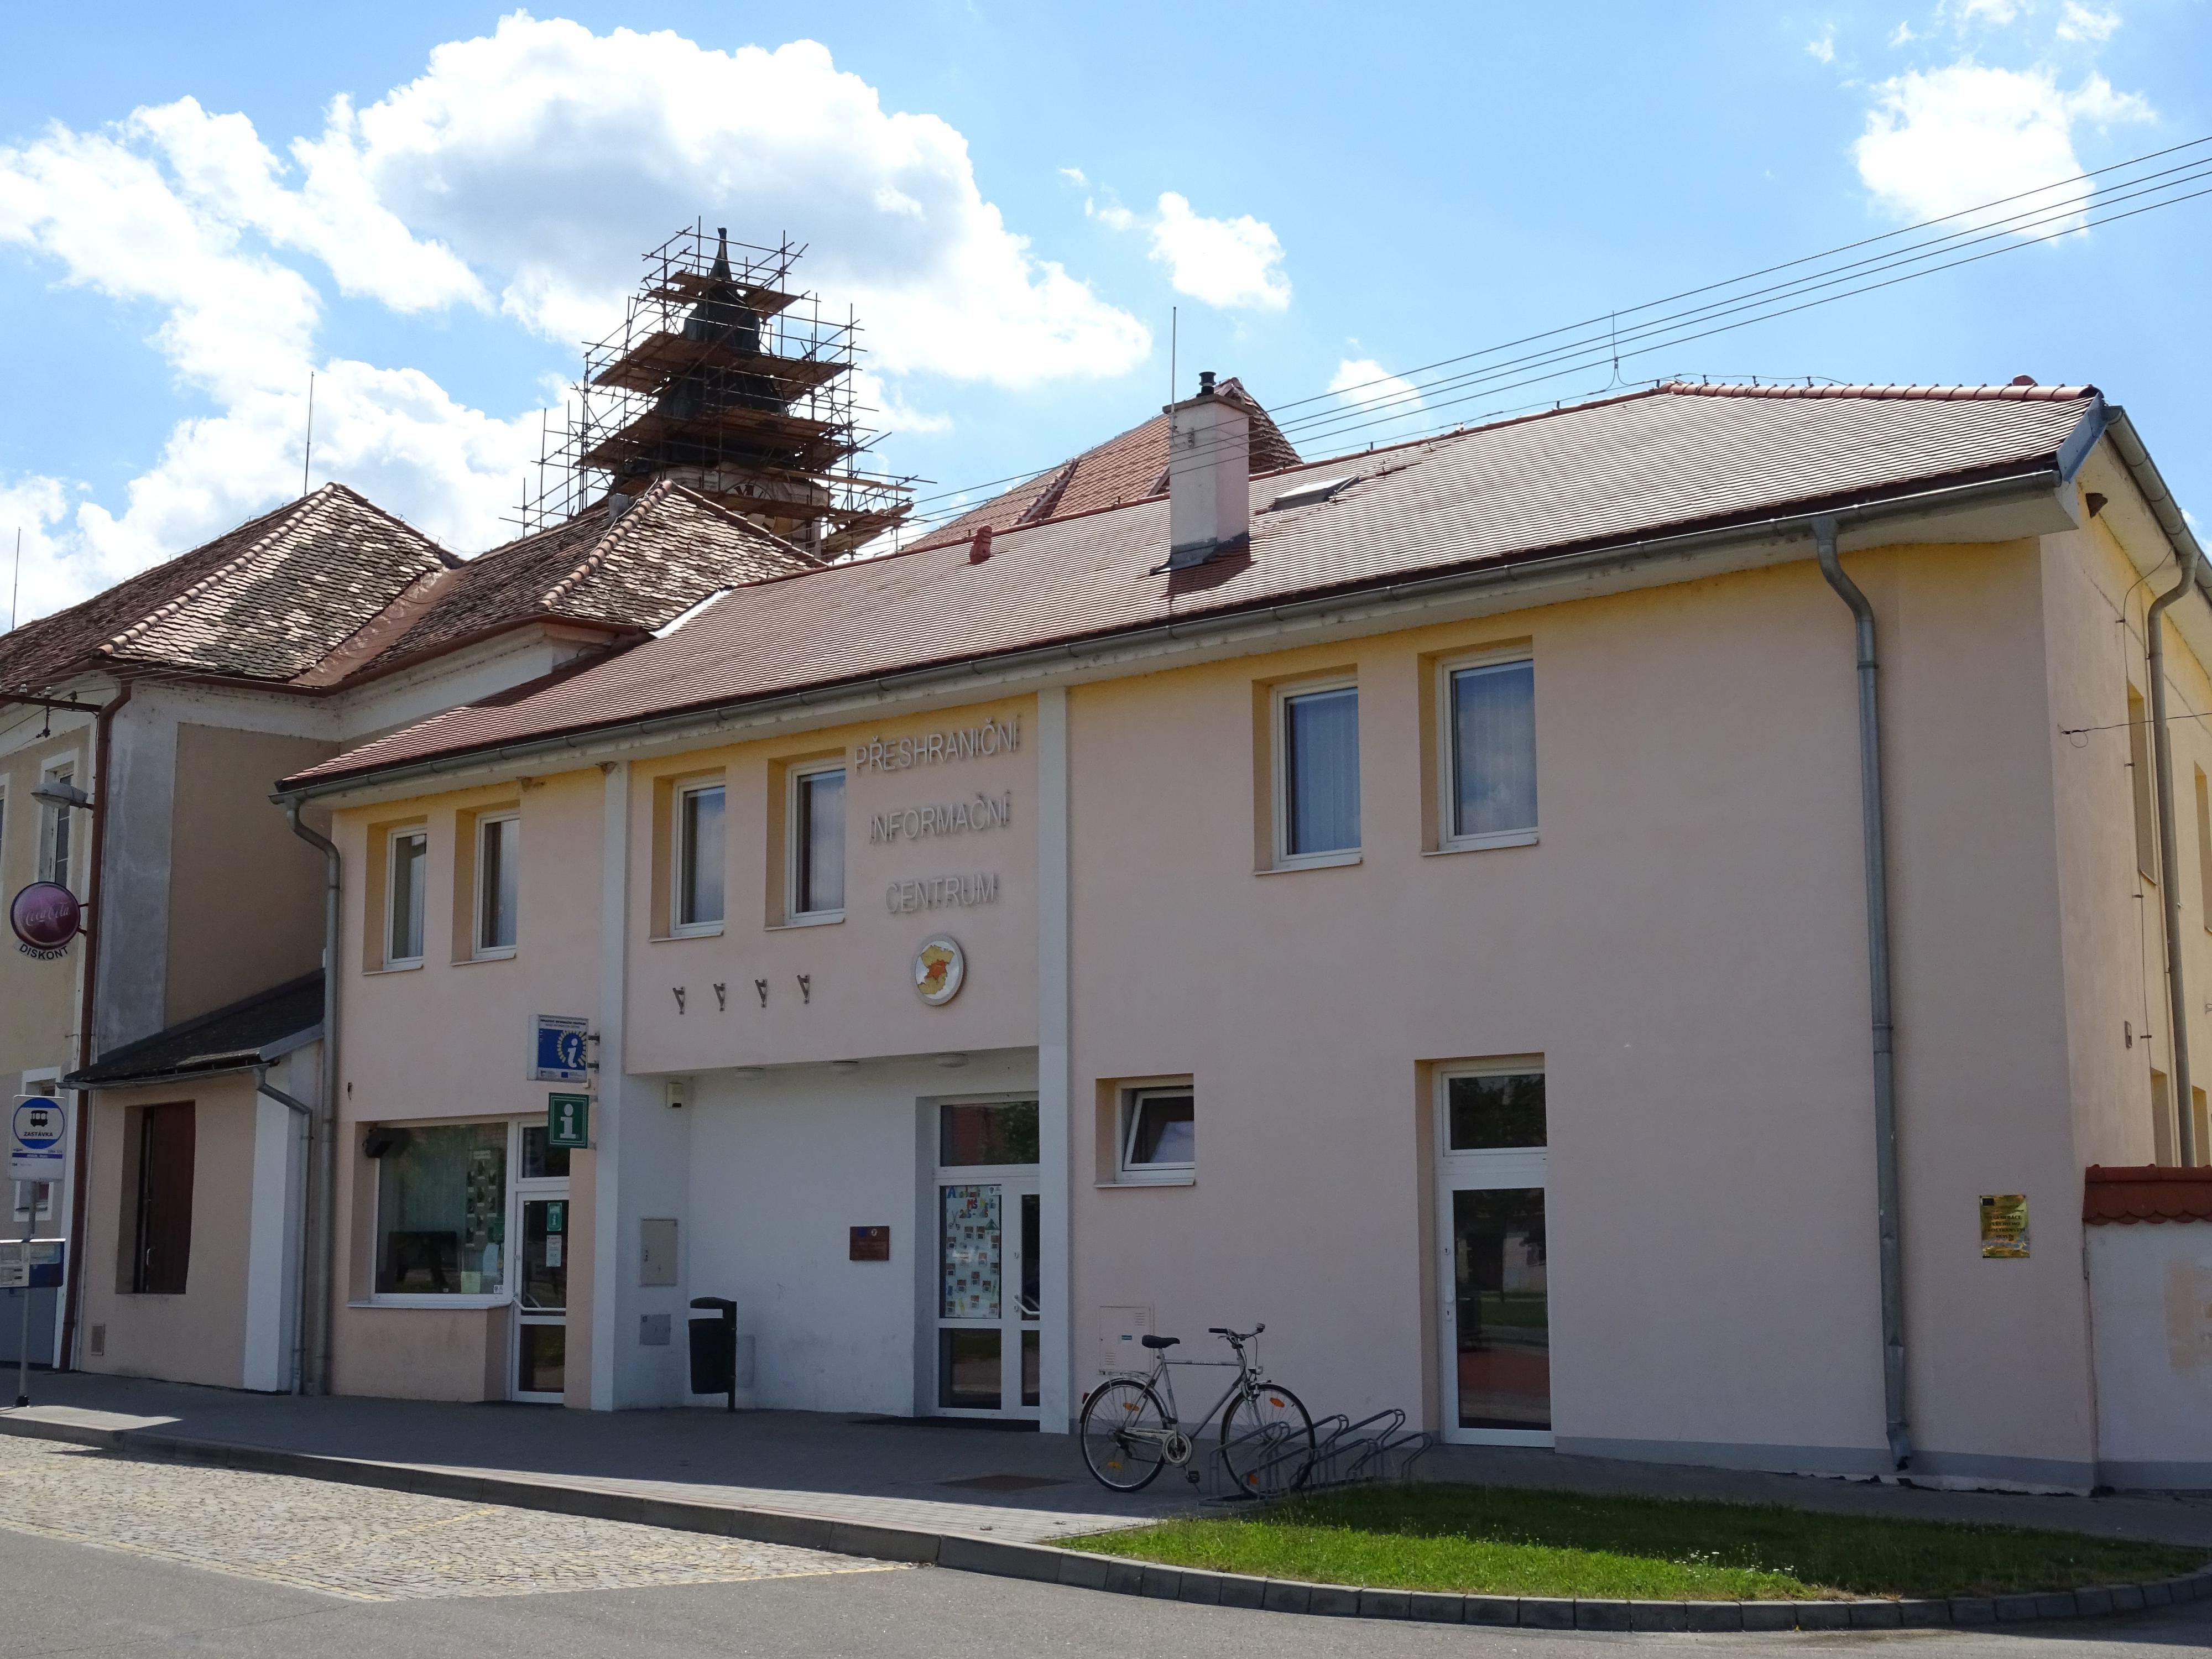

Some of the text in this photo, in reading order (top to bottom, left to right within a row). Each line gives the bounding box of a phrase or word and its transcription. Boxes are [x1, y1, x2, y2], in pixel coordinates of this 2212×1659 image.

[854, 714, 1021, 774] PŘESHRANIČNÍ
[869, 789, 1013, 844] INFORMAČNÍ
[885, 873, 998, 914] CENTRUM
[19, 943, 68, 960] DISKONT
